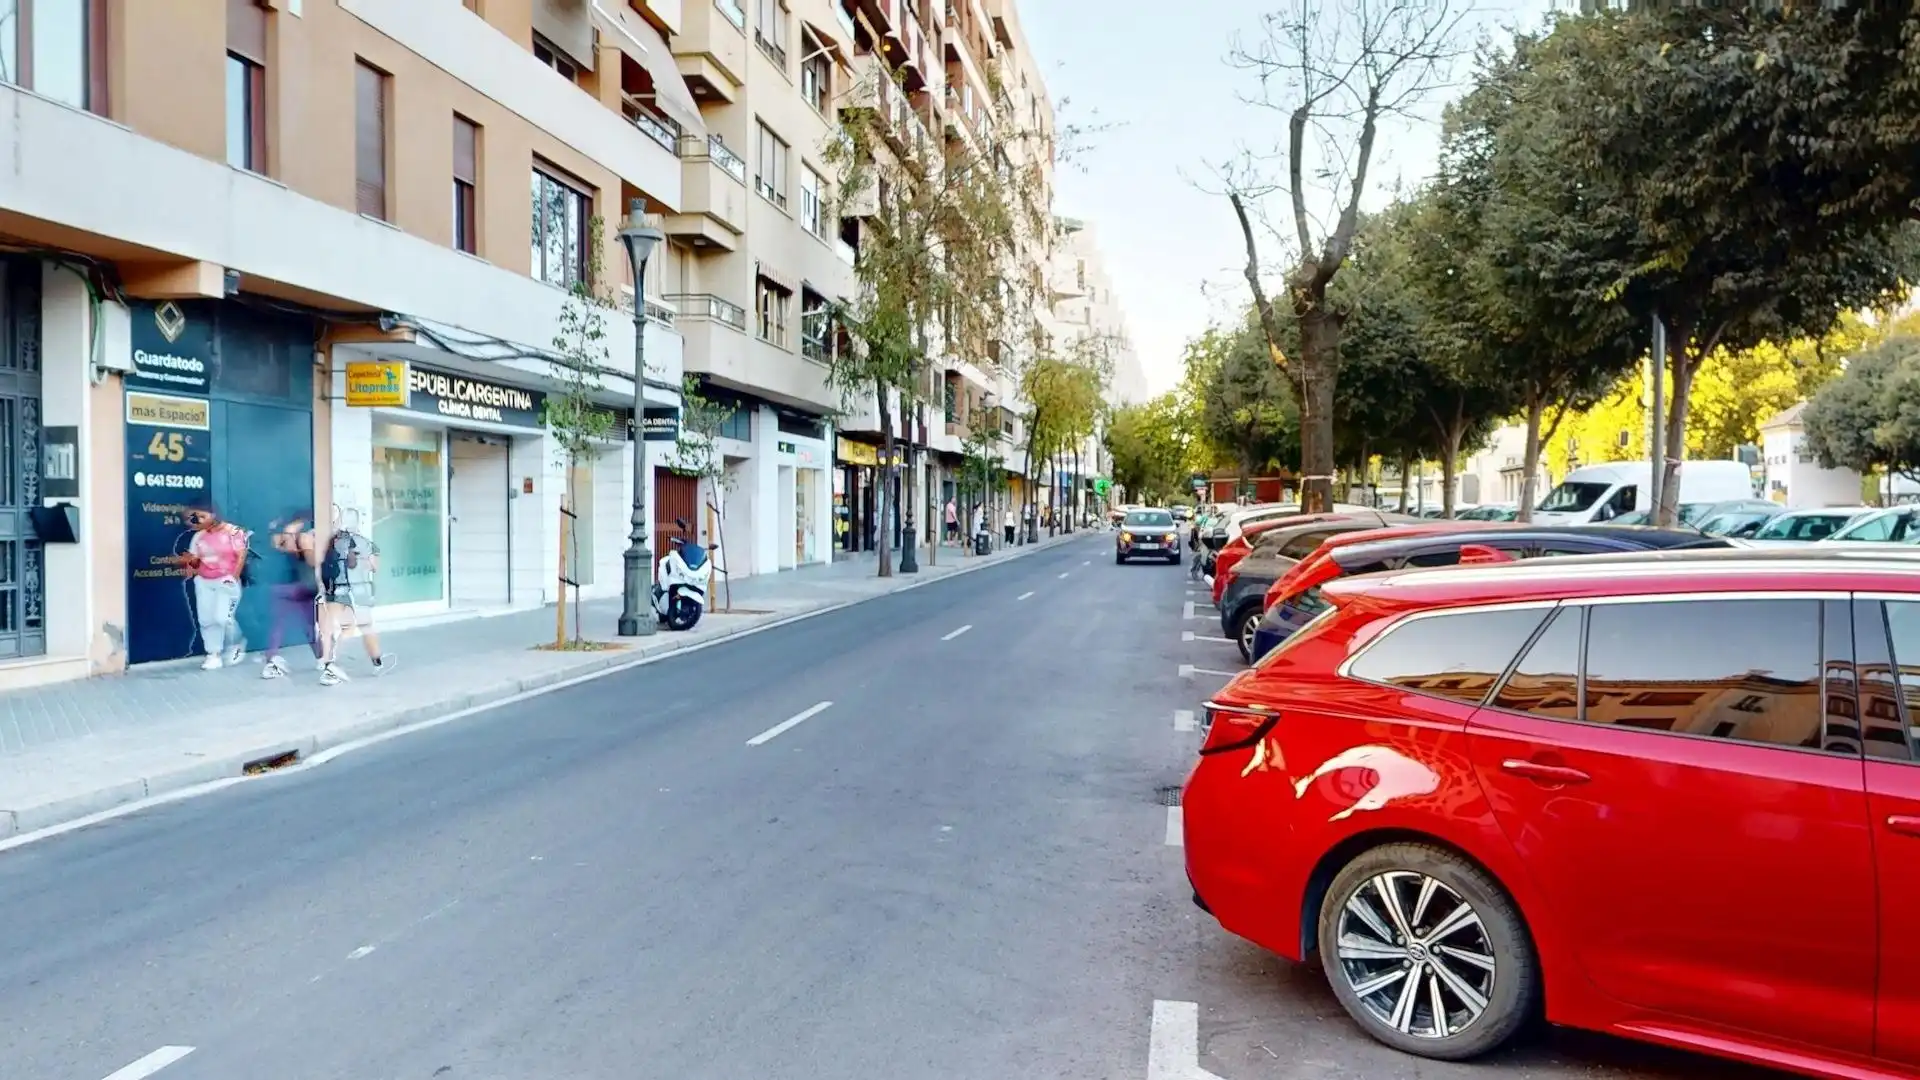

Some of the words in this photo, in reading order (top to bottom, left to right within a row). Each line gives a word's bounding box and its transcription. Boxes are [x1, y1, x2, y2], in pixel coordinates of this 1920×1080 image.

[134, 349, 205, 373] Guardatodo
[408, 369, 533, 411] EPÚBLICARGENTINA
[472, 405, 503, 422] DENTAL
[652, 417, 678, 426] DENTAL
[147, 474, 164, 487] 641
[166, 475, 183, 487] 522
[185, 476, 203, 488] 800
[164, 516, 173, 525] 24
[134, 569, 162, 577] Acceso
